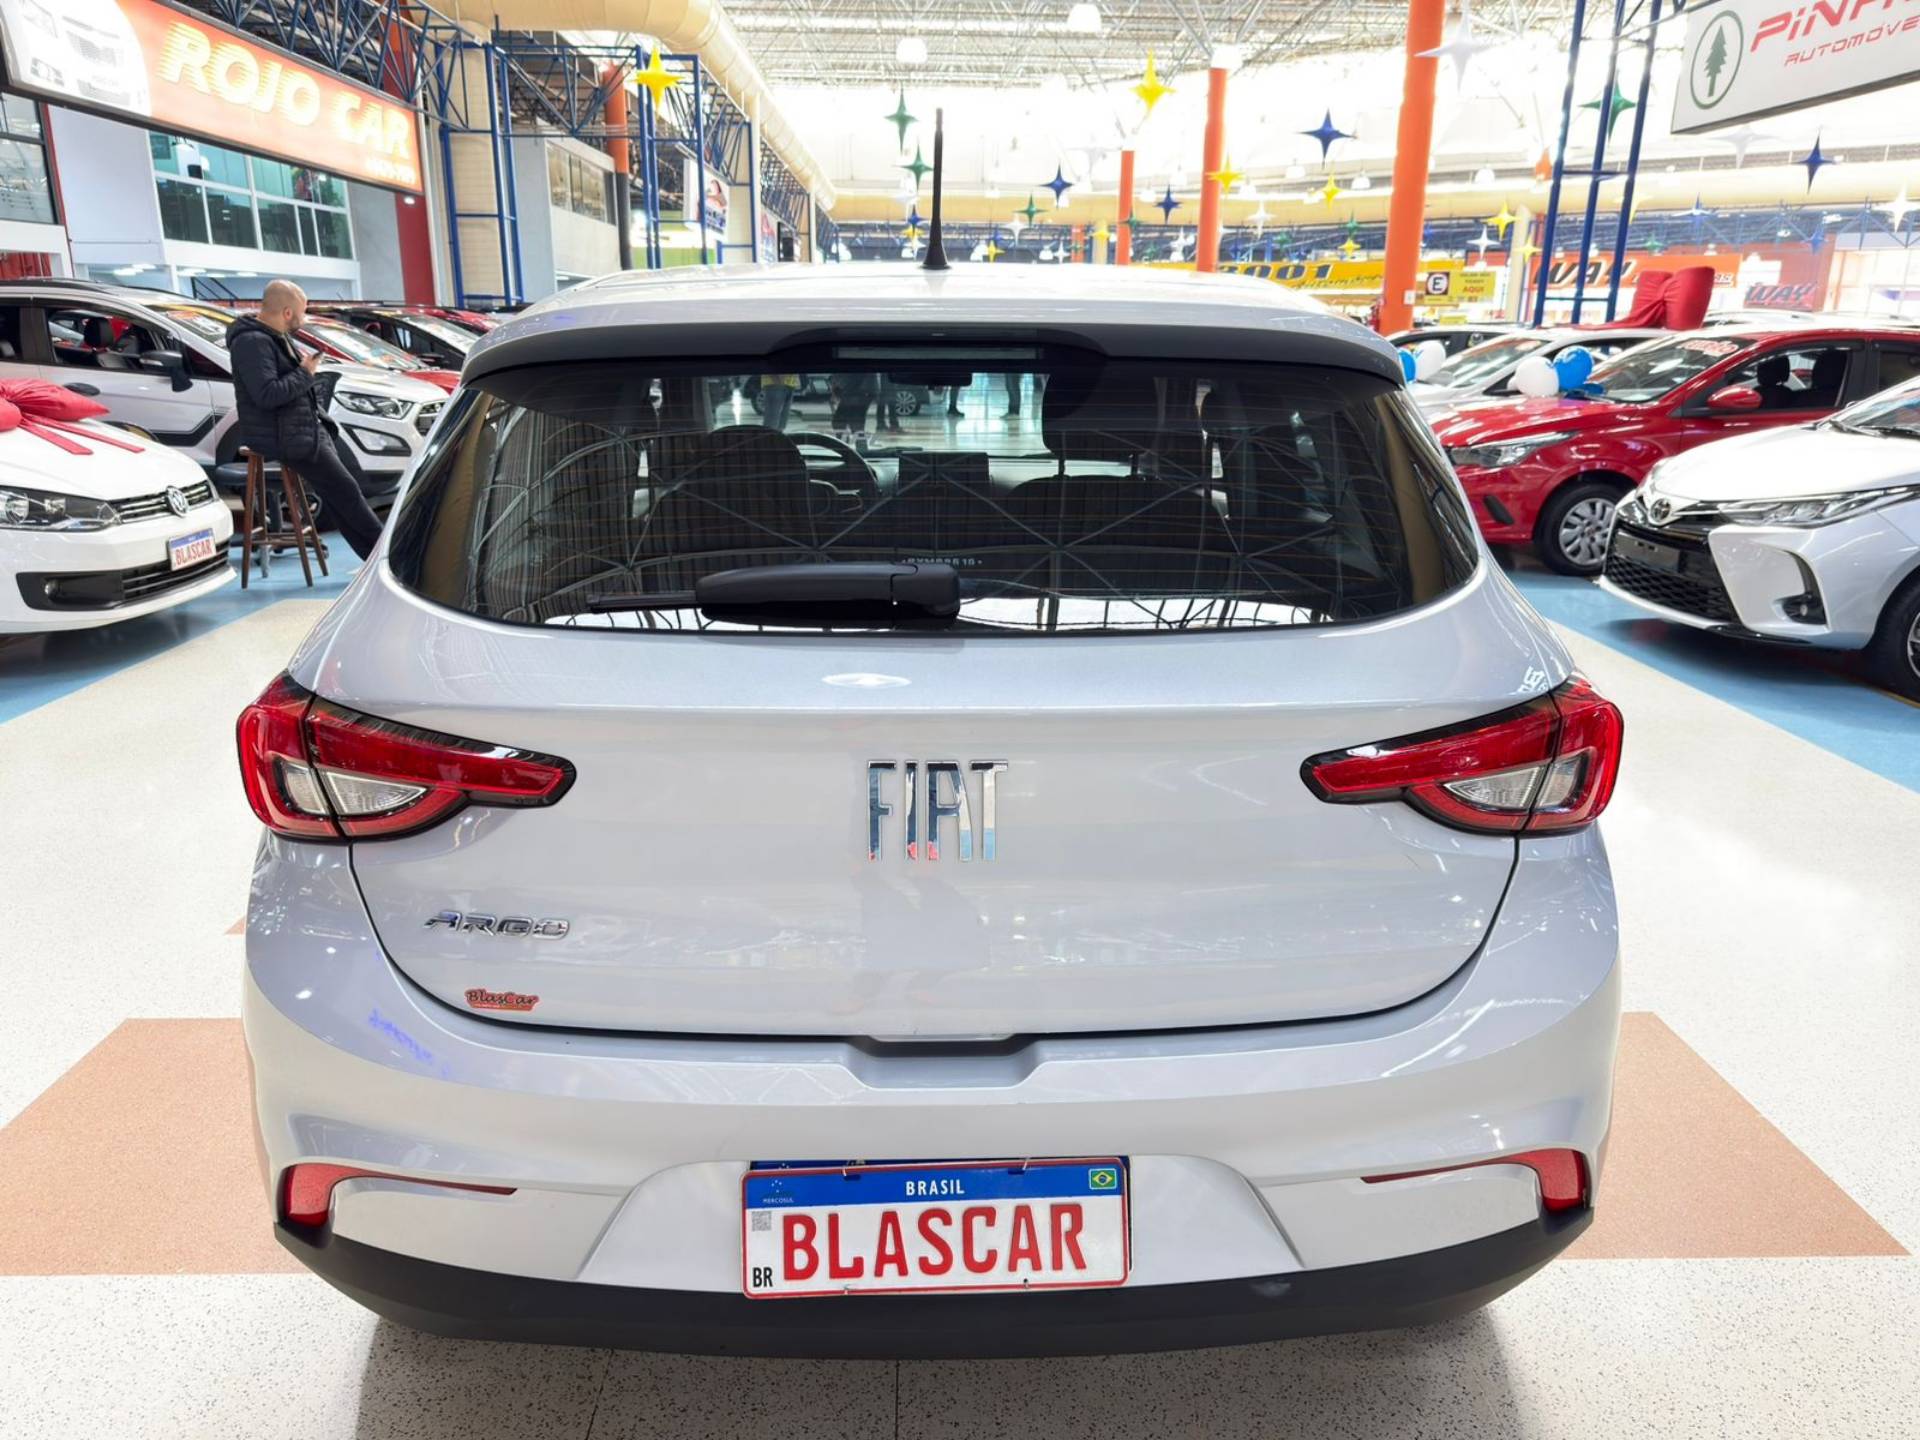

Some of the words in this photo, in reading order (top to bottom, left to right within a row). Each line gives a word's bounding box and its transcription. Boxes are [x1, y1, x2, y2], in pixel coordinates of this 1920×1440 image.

[157, 22, 320, 126] ROJO
[331, 92, 410, 157] CAR
[1432, 276, 1444, 292] E
[175, 540, 212, 565] BLASCAR
[868, 760, 1009, 862] FIAT
[424, 910, 570, 941] ARGO
[905, 1179, 966, 1196] BRASIL
[782, 1203, 1087, 1281] BLASCAR
[752, 1267, 774, 1288] BR
